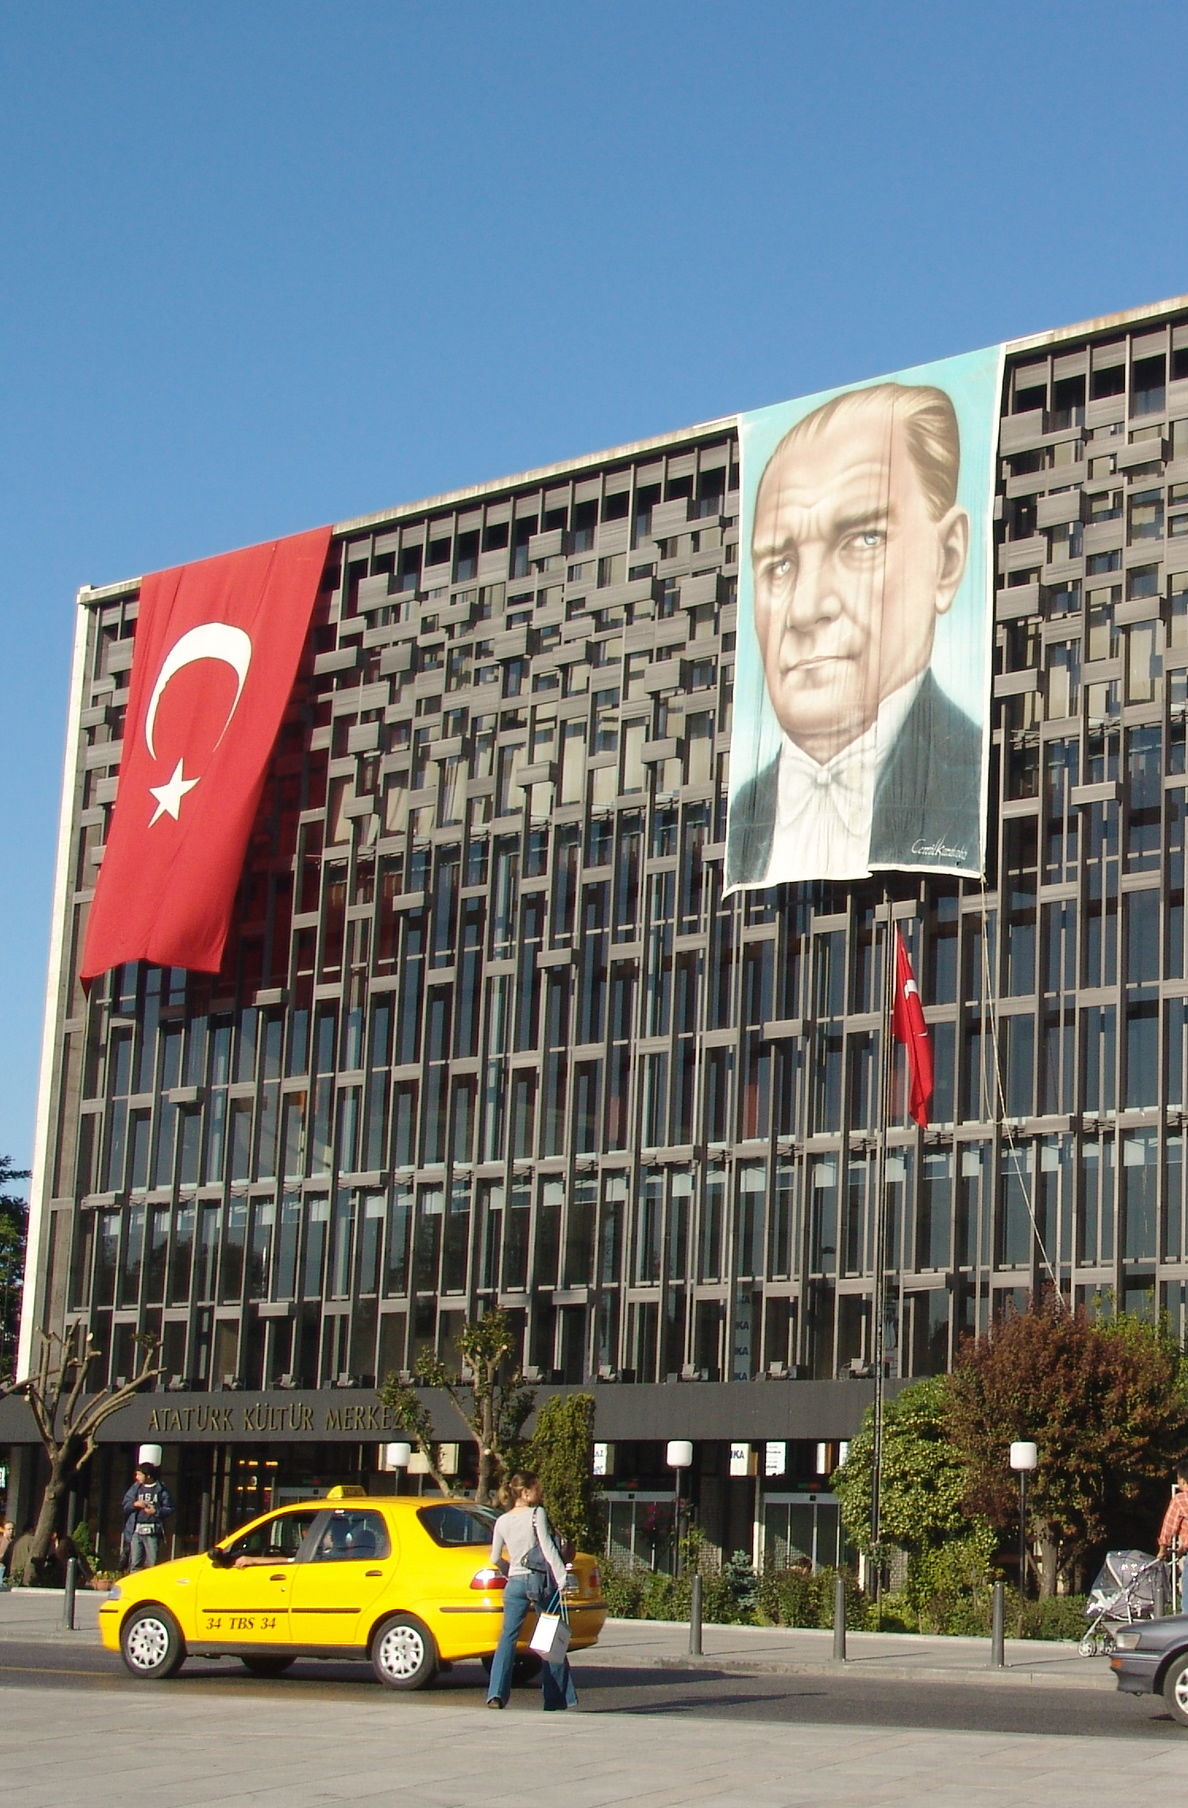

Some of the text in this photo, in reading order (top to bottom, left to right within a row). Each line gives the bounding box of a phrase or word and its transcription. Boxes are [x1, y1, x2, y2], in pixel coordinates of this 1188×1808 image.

[149, 1402, 405, 1432] ATATÜRK KÜLTÜR MERKEZ
[206, 1617, 277, 1630] 34 TBS 34
